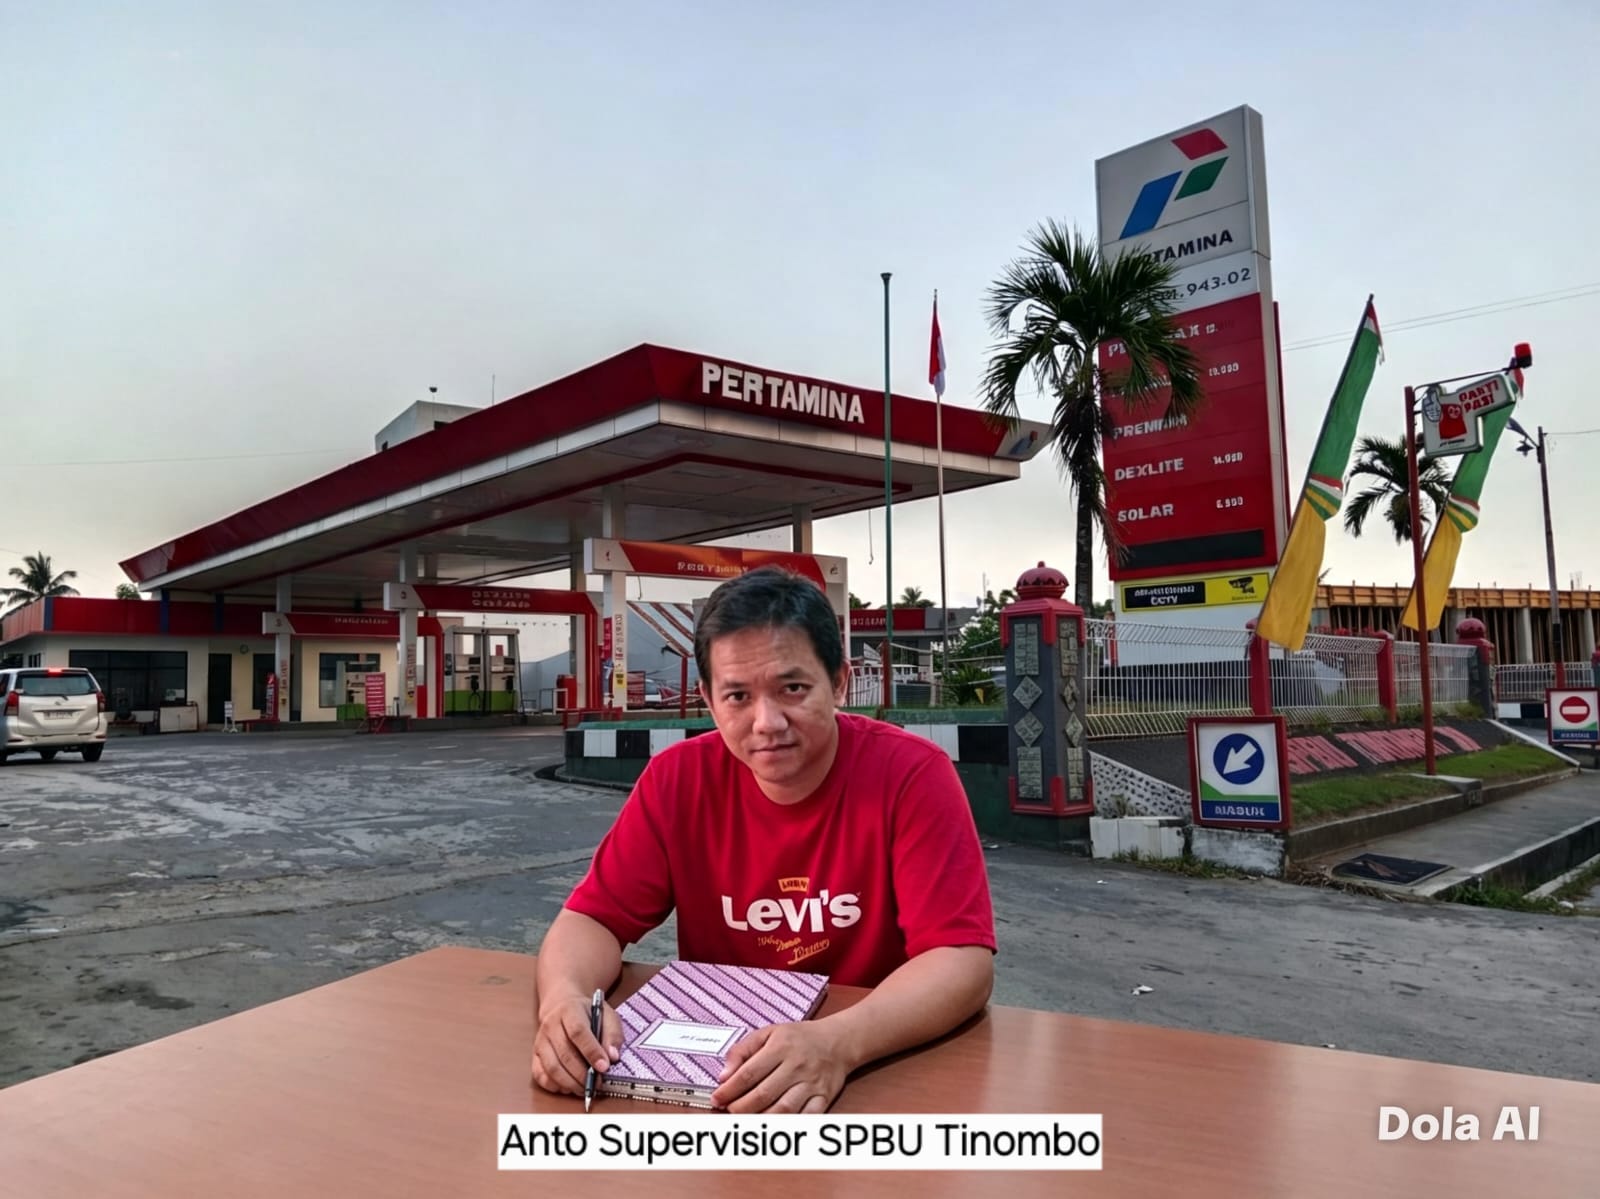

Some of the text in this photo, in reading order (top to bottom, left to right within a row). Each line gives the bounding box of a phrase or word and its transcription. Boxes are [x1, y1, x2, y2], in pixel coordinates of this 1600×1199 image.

[702, 361, 865, 424] PERTAMINA
[1114, 457, 1184, 481] DEXLITE
[1117, 503, 1174, 522] SOLAR
[721, 888, 862, 933] Levi's
